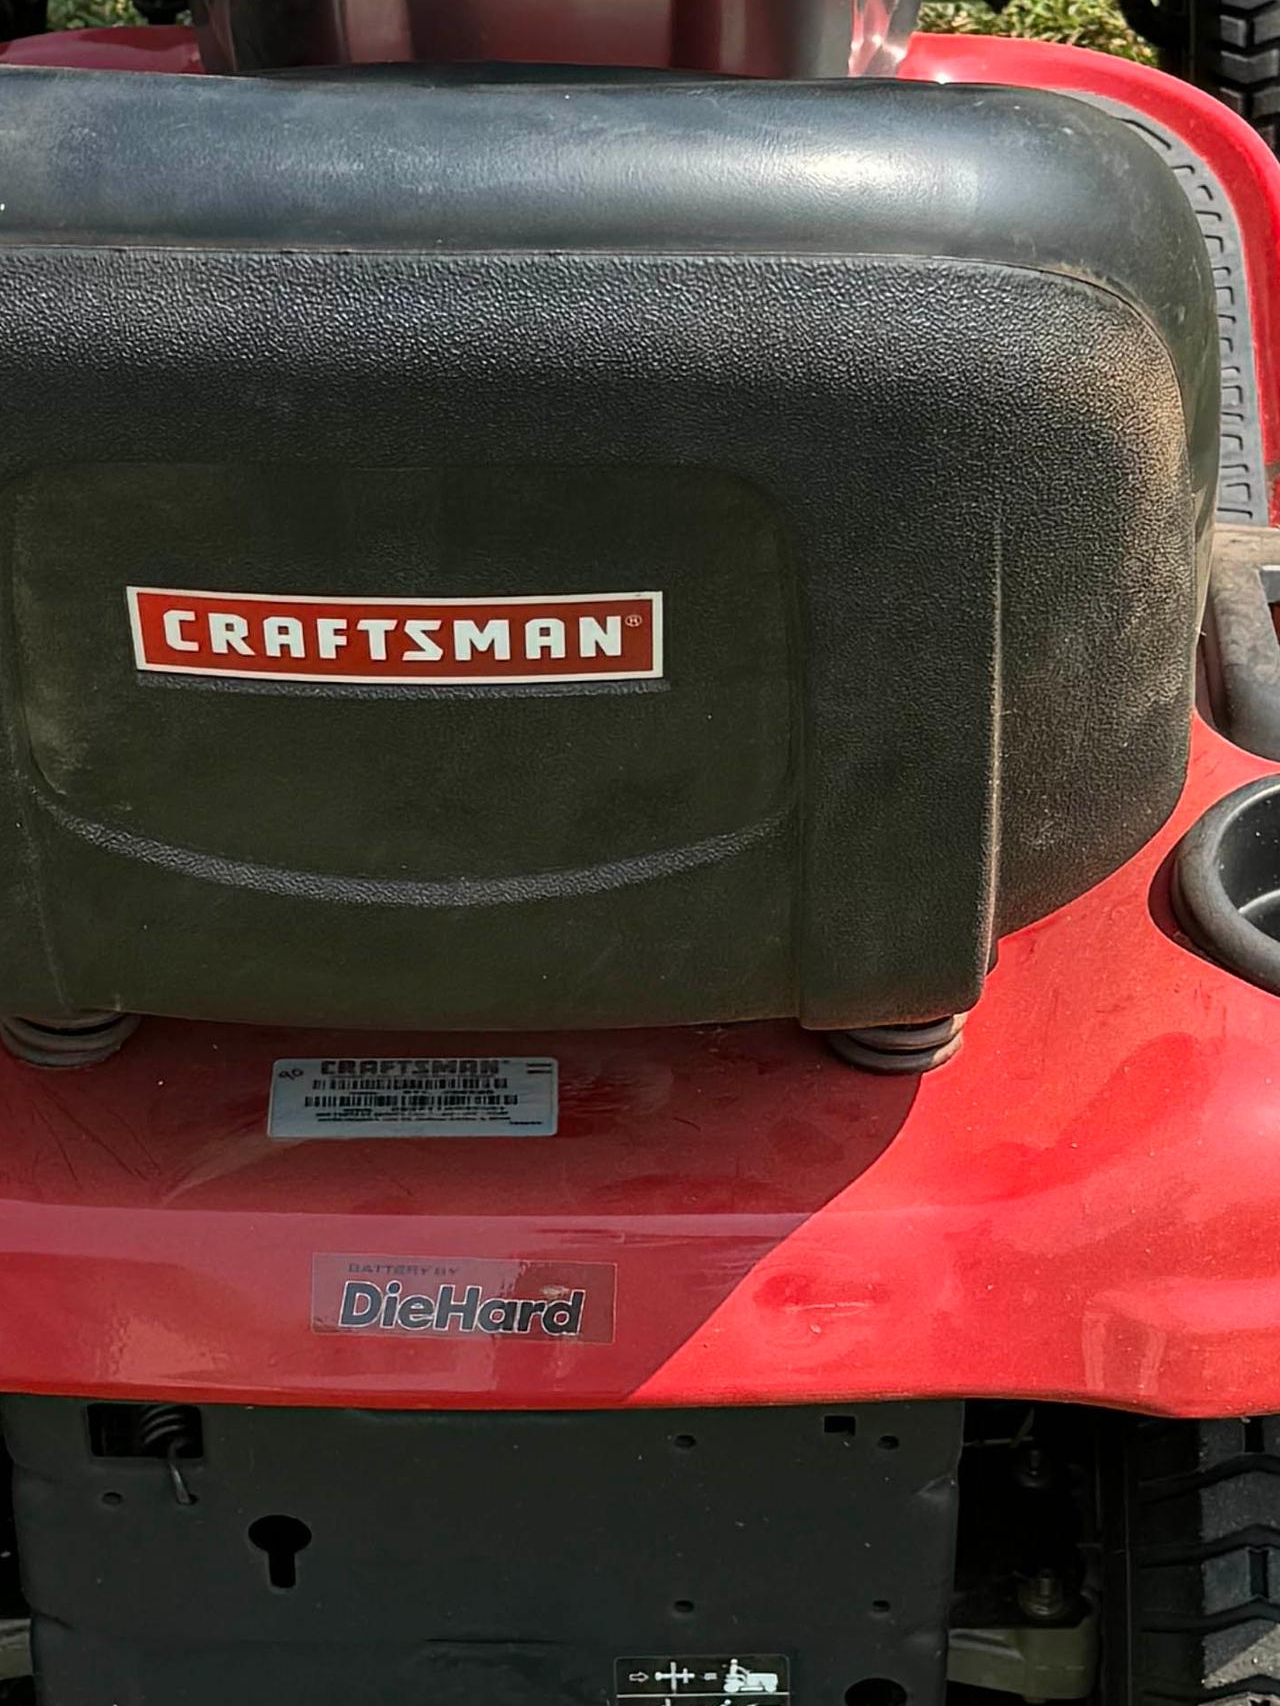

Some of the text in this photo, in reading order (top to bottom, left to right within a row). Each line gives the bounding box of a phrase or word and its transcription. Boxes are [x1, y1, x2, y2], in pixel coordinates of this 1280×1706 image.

[320, 1059, 501, 1076] CRAFTSMAN
[348, 1262, 428, 1275] BATTERY
[338, 1279, 587, 1337] DieHard
